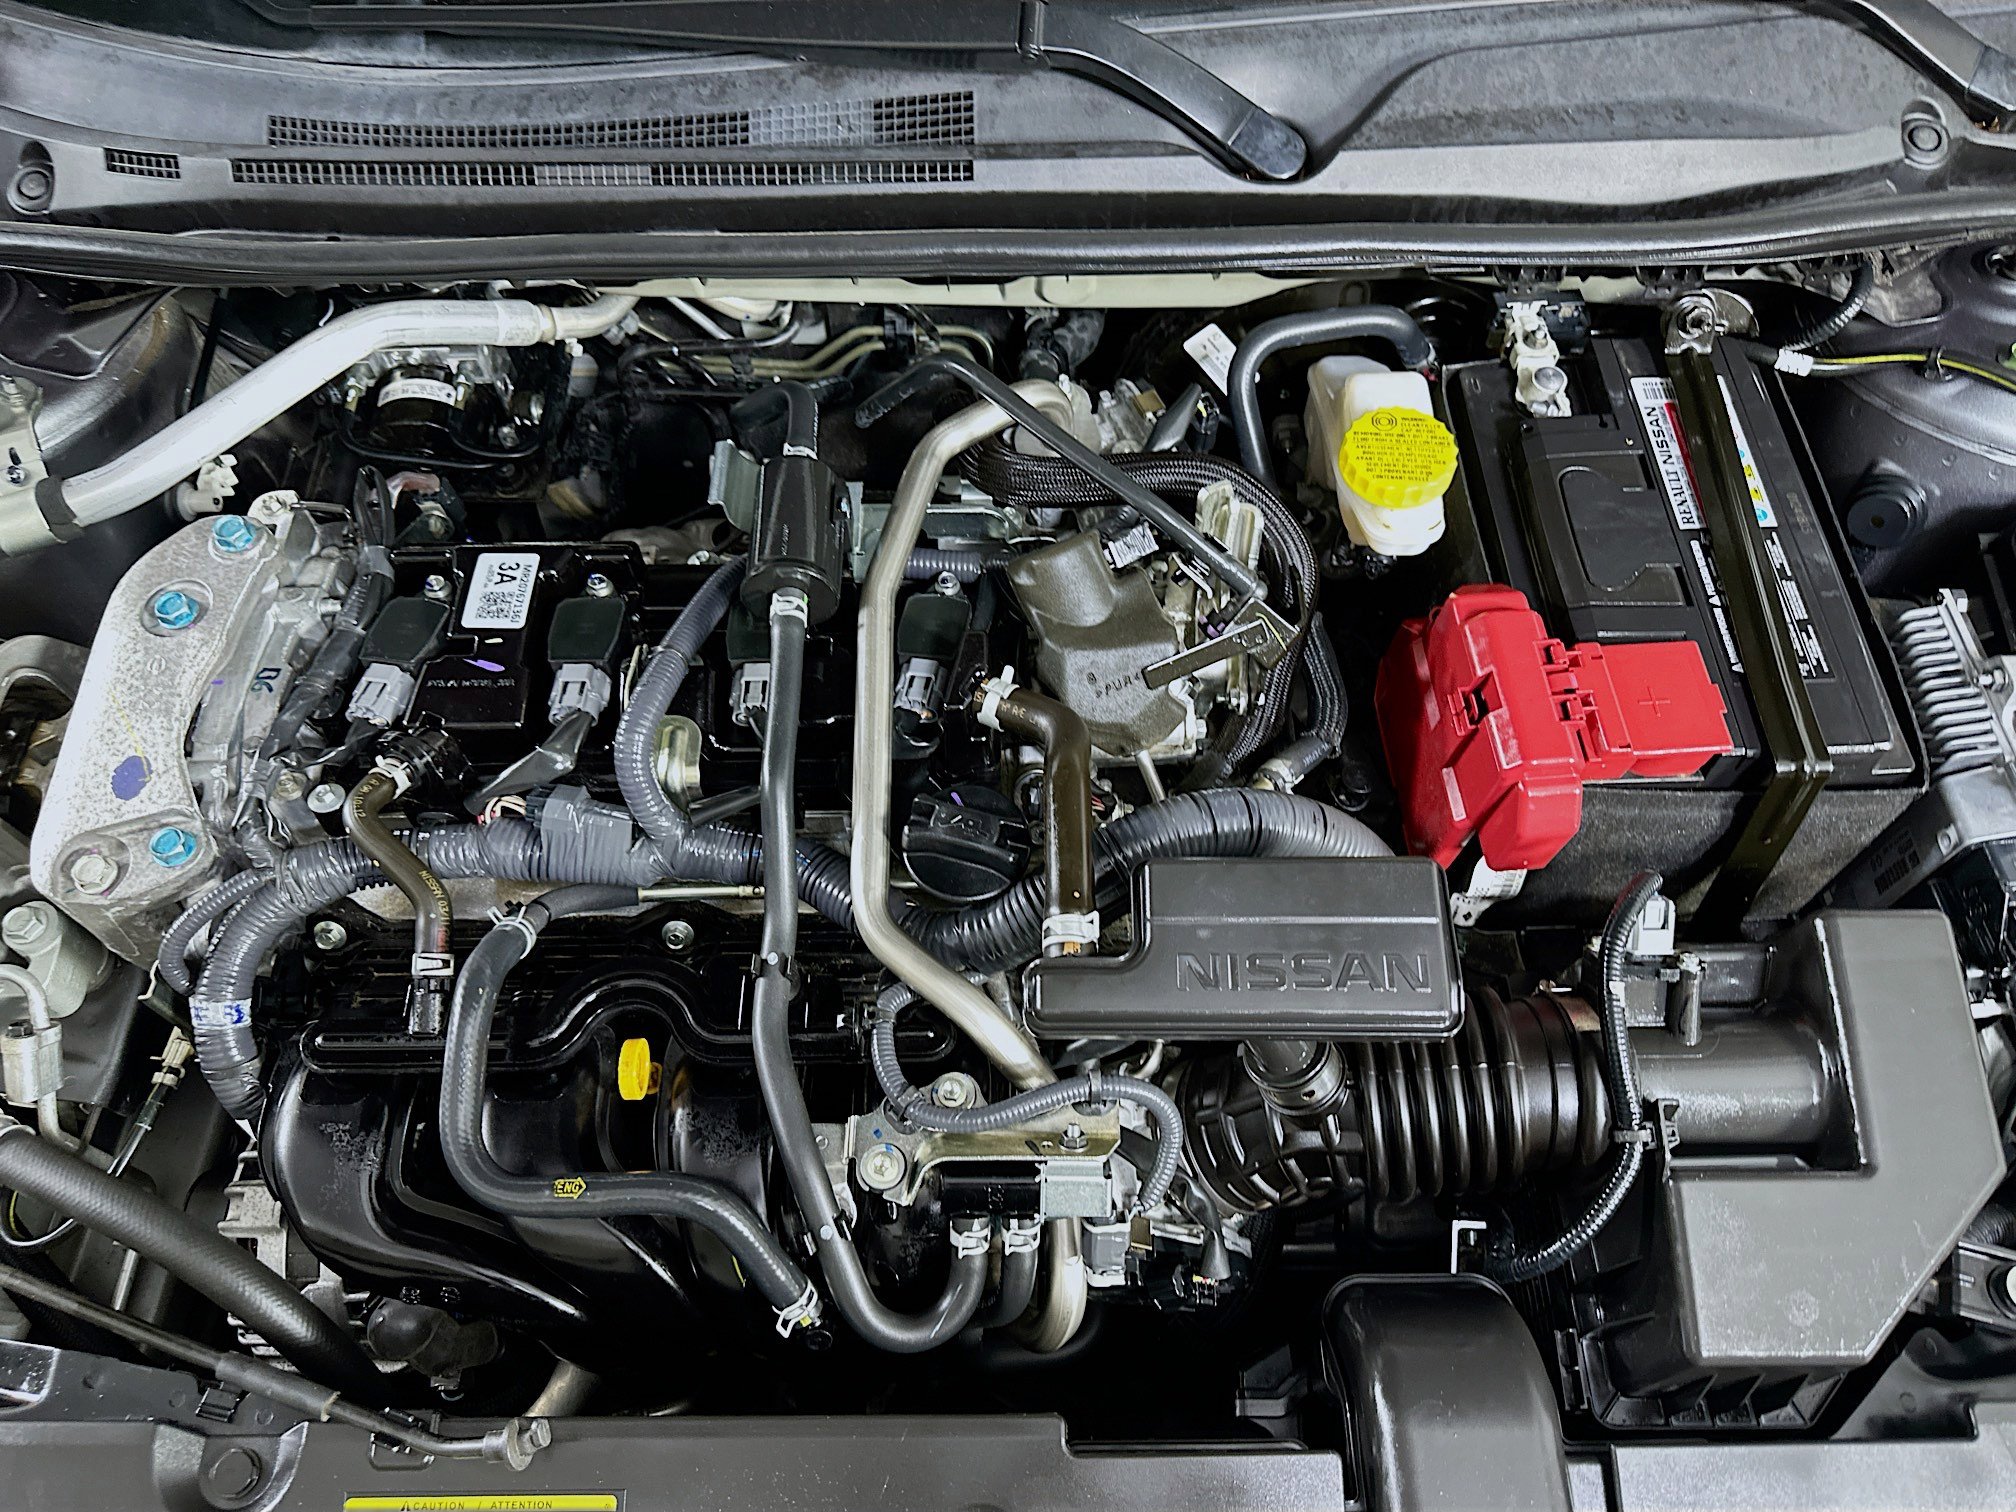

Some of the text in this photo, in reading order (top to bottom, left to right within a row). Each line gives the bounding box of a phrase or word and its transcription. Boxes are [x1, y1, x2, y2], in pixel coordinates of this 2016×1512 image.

[1644, 406, 1675, 465] NISSAN
[1665, 470, 1696, 526] RENAULT
[494, 562, 520, 586] 3A
[418, 870, 444, 900] NISSAN
[1176, 953, 1432, 992] NISSAN
[556, 1181, 580, 1194] ENG
[413, 1501, 465, 1511] CAUTION
[490, 1500, 553, 1510] ATTENTION
